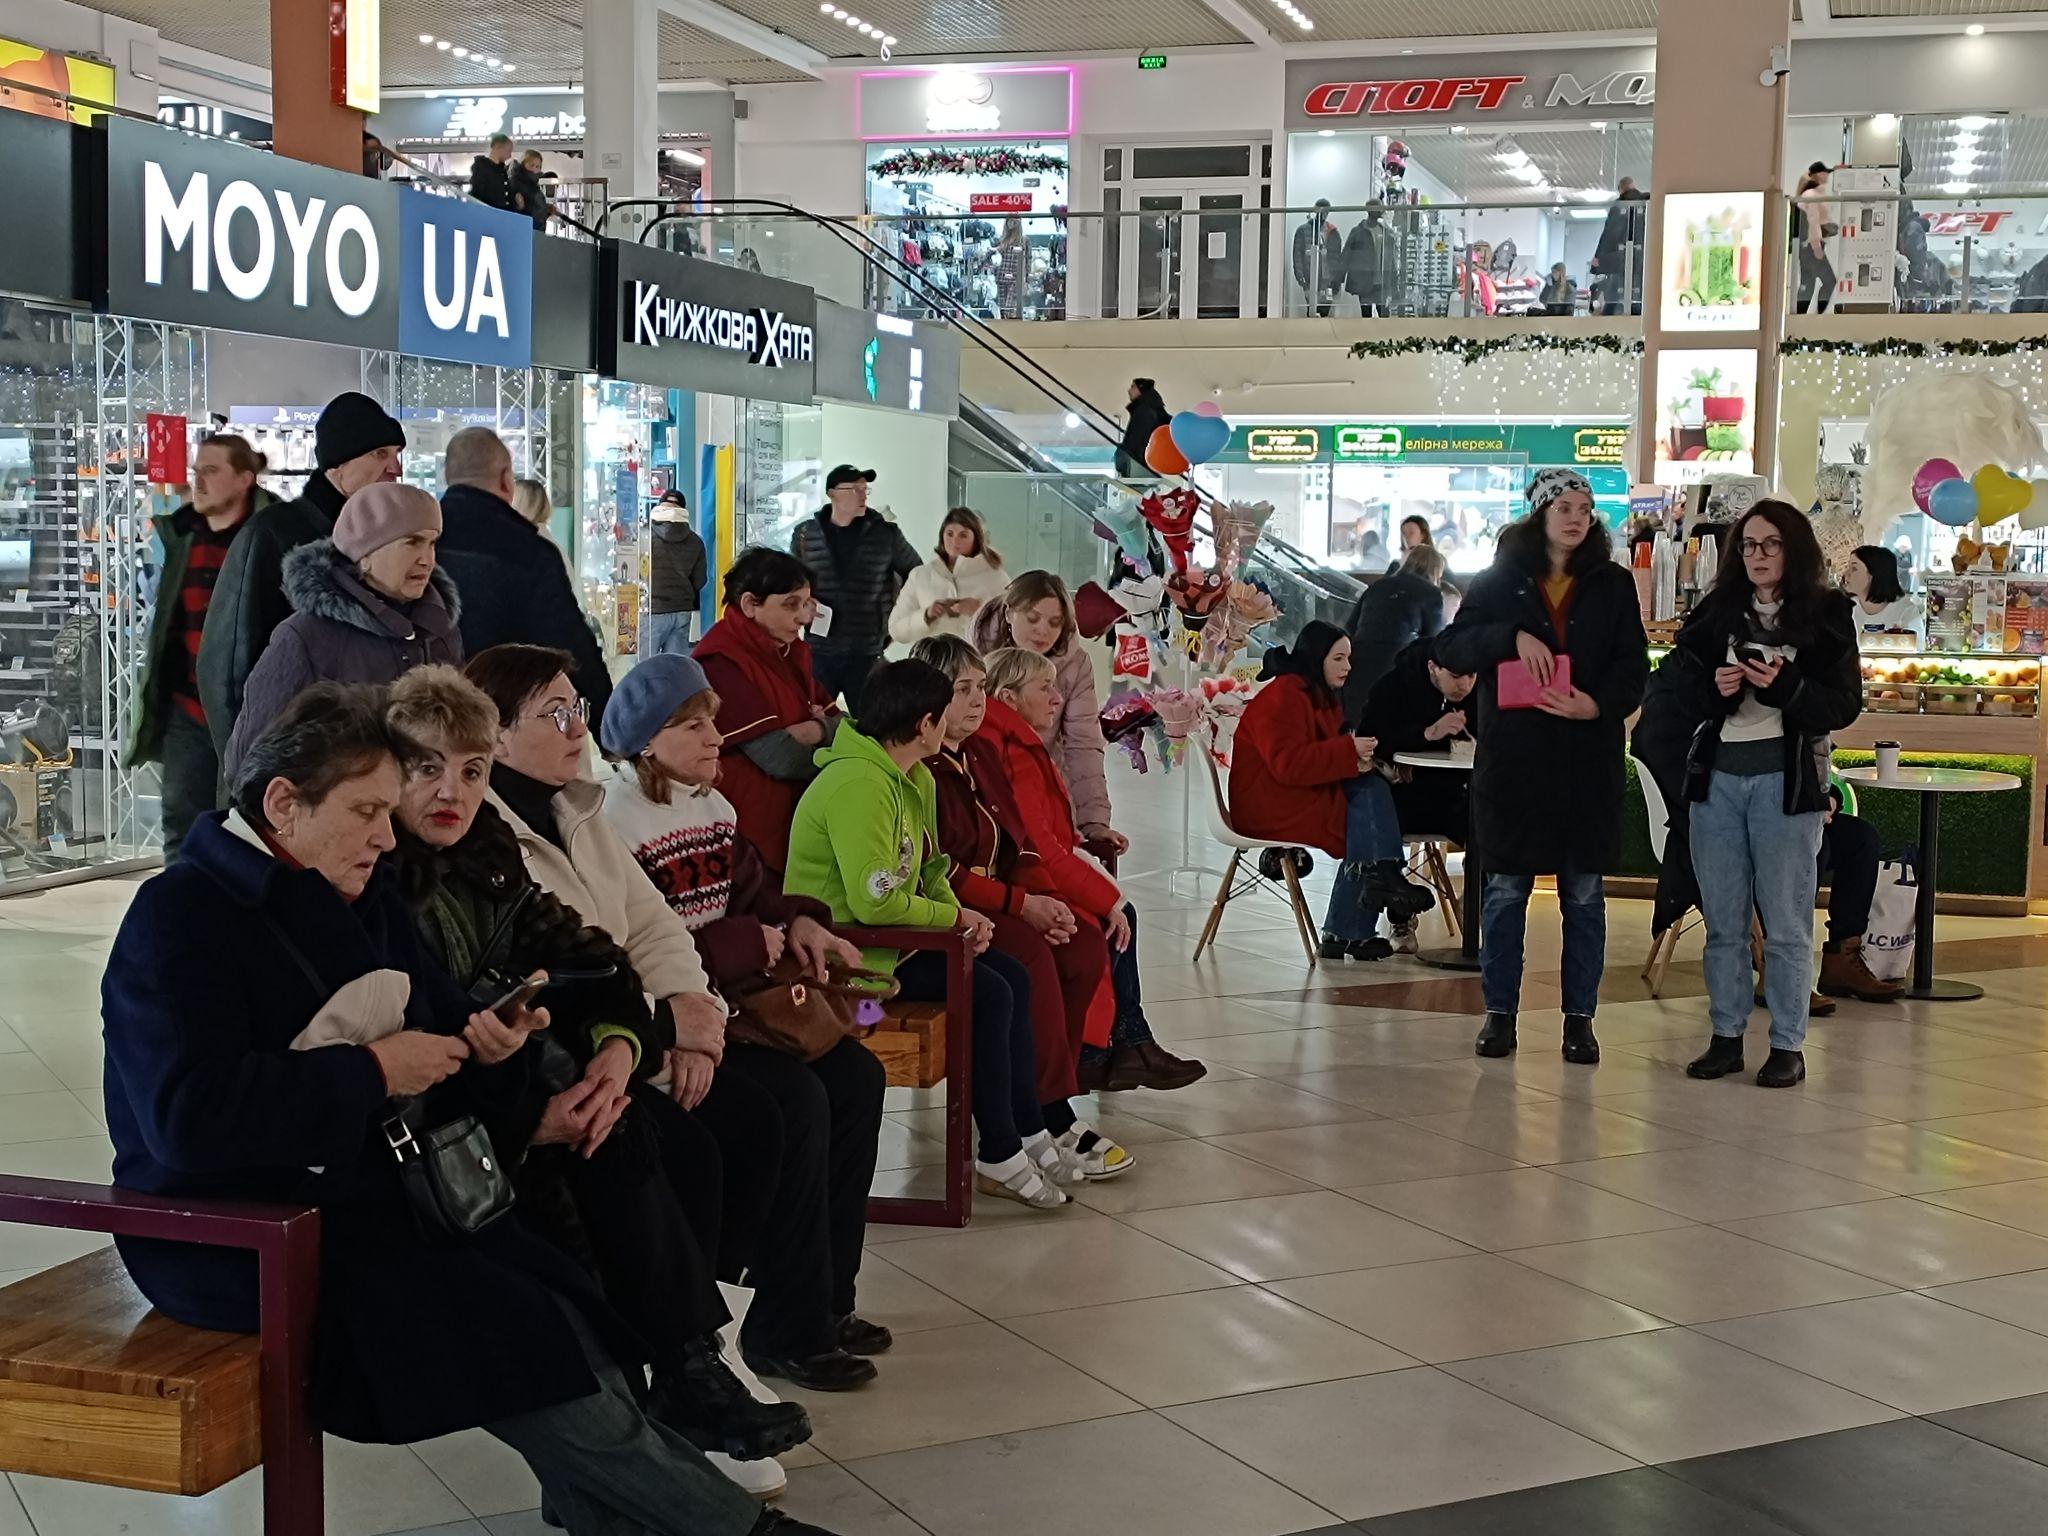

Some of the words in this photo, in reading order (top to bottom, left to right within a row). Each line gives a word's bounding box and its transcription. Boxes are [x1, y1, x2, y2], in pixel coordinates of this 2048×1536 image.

[1303, 75, 1527, 116] СПОРТ
[1522, 95, 1536, 109] &
[970, 195, 1000, 206] SALE
[1002, 194, 1031, 206] -40%
[144, 161, 380, 317] MOYO
[422, 222, 511, 338] UA
[1405, 438, 1448, 451] елірна
[1452, 440, 1503, 451] мережа
